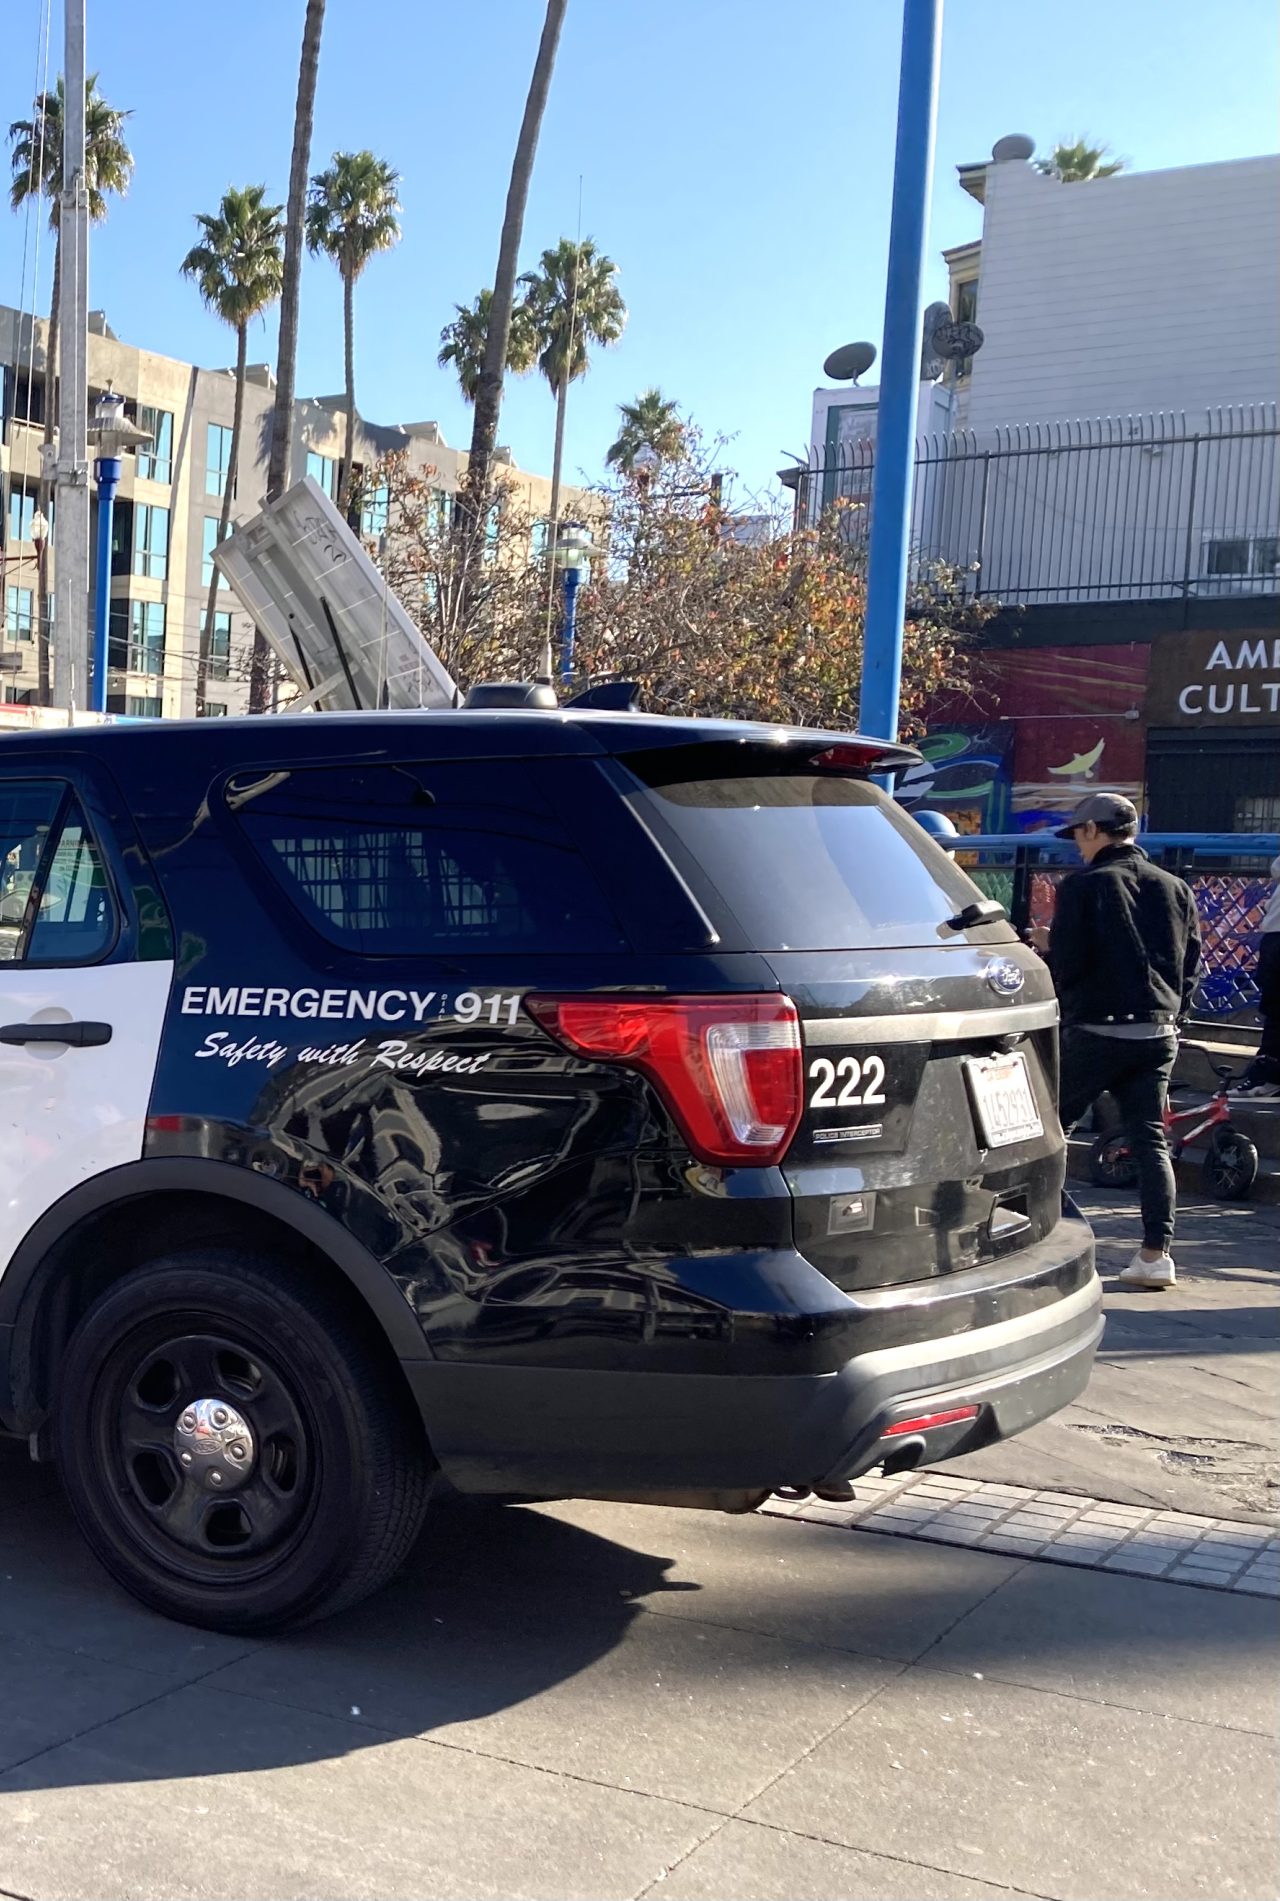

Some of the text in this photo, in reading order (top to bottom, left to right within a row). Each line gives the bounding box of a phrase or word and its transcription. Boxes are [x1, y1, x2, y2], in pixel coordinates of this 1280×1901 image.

[1179, 683, 1280, 714] CULT
[181, 986, 437, 1021] EMERGENCY
[454, 992, 521, 1025] 911
[194, 1031, 491, 1077] Safety with Respect
[809, 1056, 886, 1107] 222
